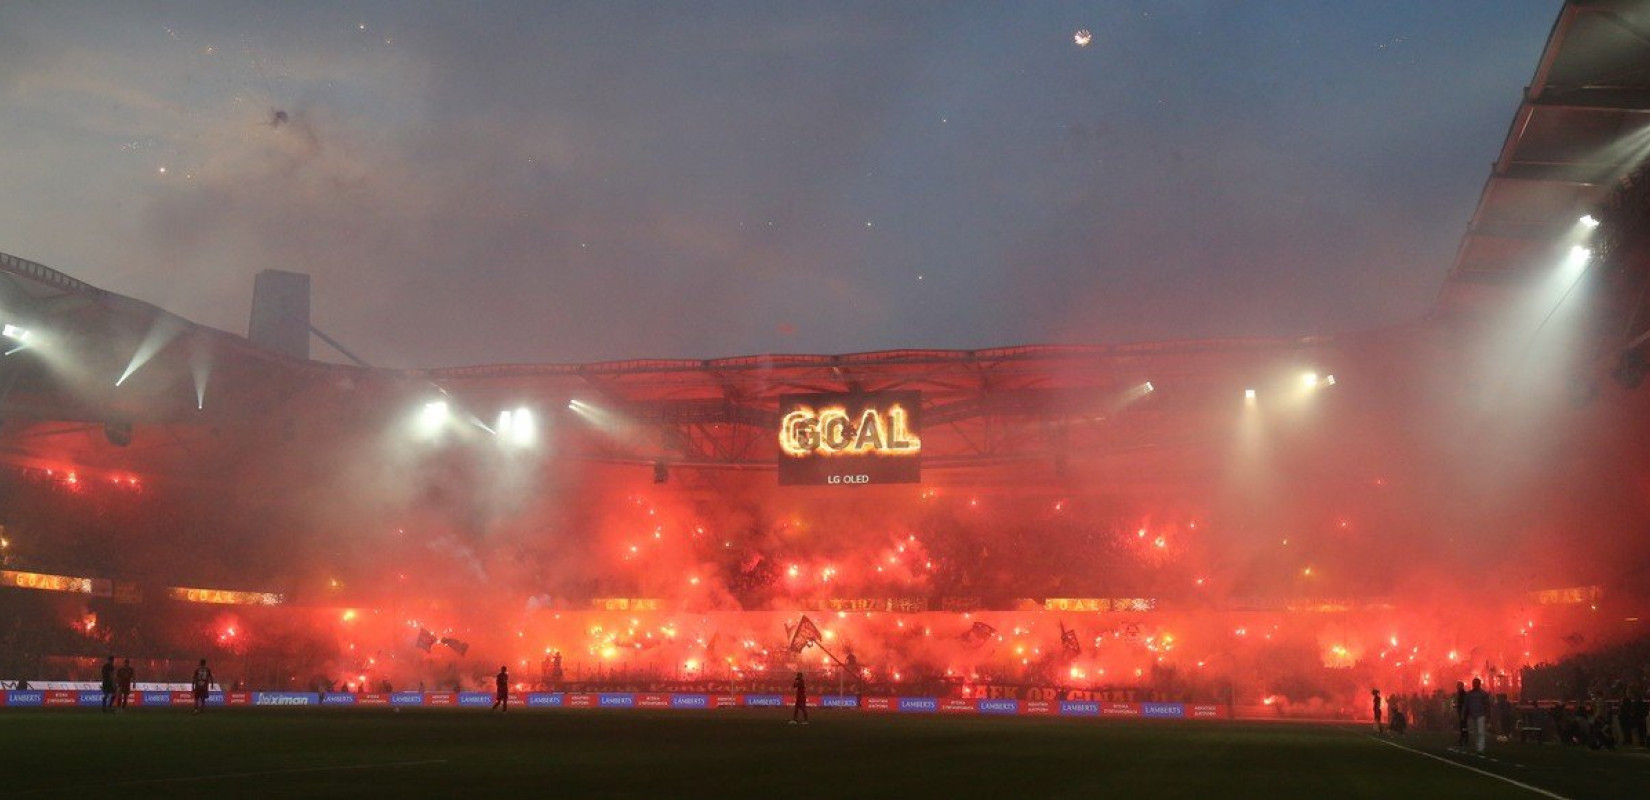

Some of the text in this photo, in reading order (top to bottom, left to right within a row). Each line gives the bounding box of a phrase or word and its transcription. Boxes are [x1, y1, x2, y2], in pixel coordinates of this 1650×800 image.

[780, 405, 922, 456] GOAL
[828, 475, 869, 484] LG OLED
[601, 697, 633, 705] LAMBERTS
[673, 698, 705, 706] LAMBERTS
[749, 698, 781, 706] LAMBERTS
[823, 699, 857, 707] LAMBERTS
[901, 700, 936, 709] LAMBERTS
[980, 702, 1015, 711] LAMBERTS
[1062, 703, 1098, 712] LAMBERTS
[1144, 705, 1181, 714] LAMBERTS
